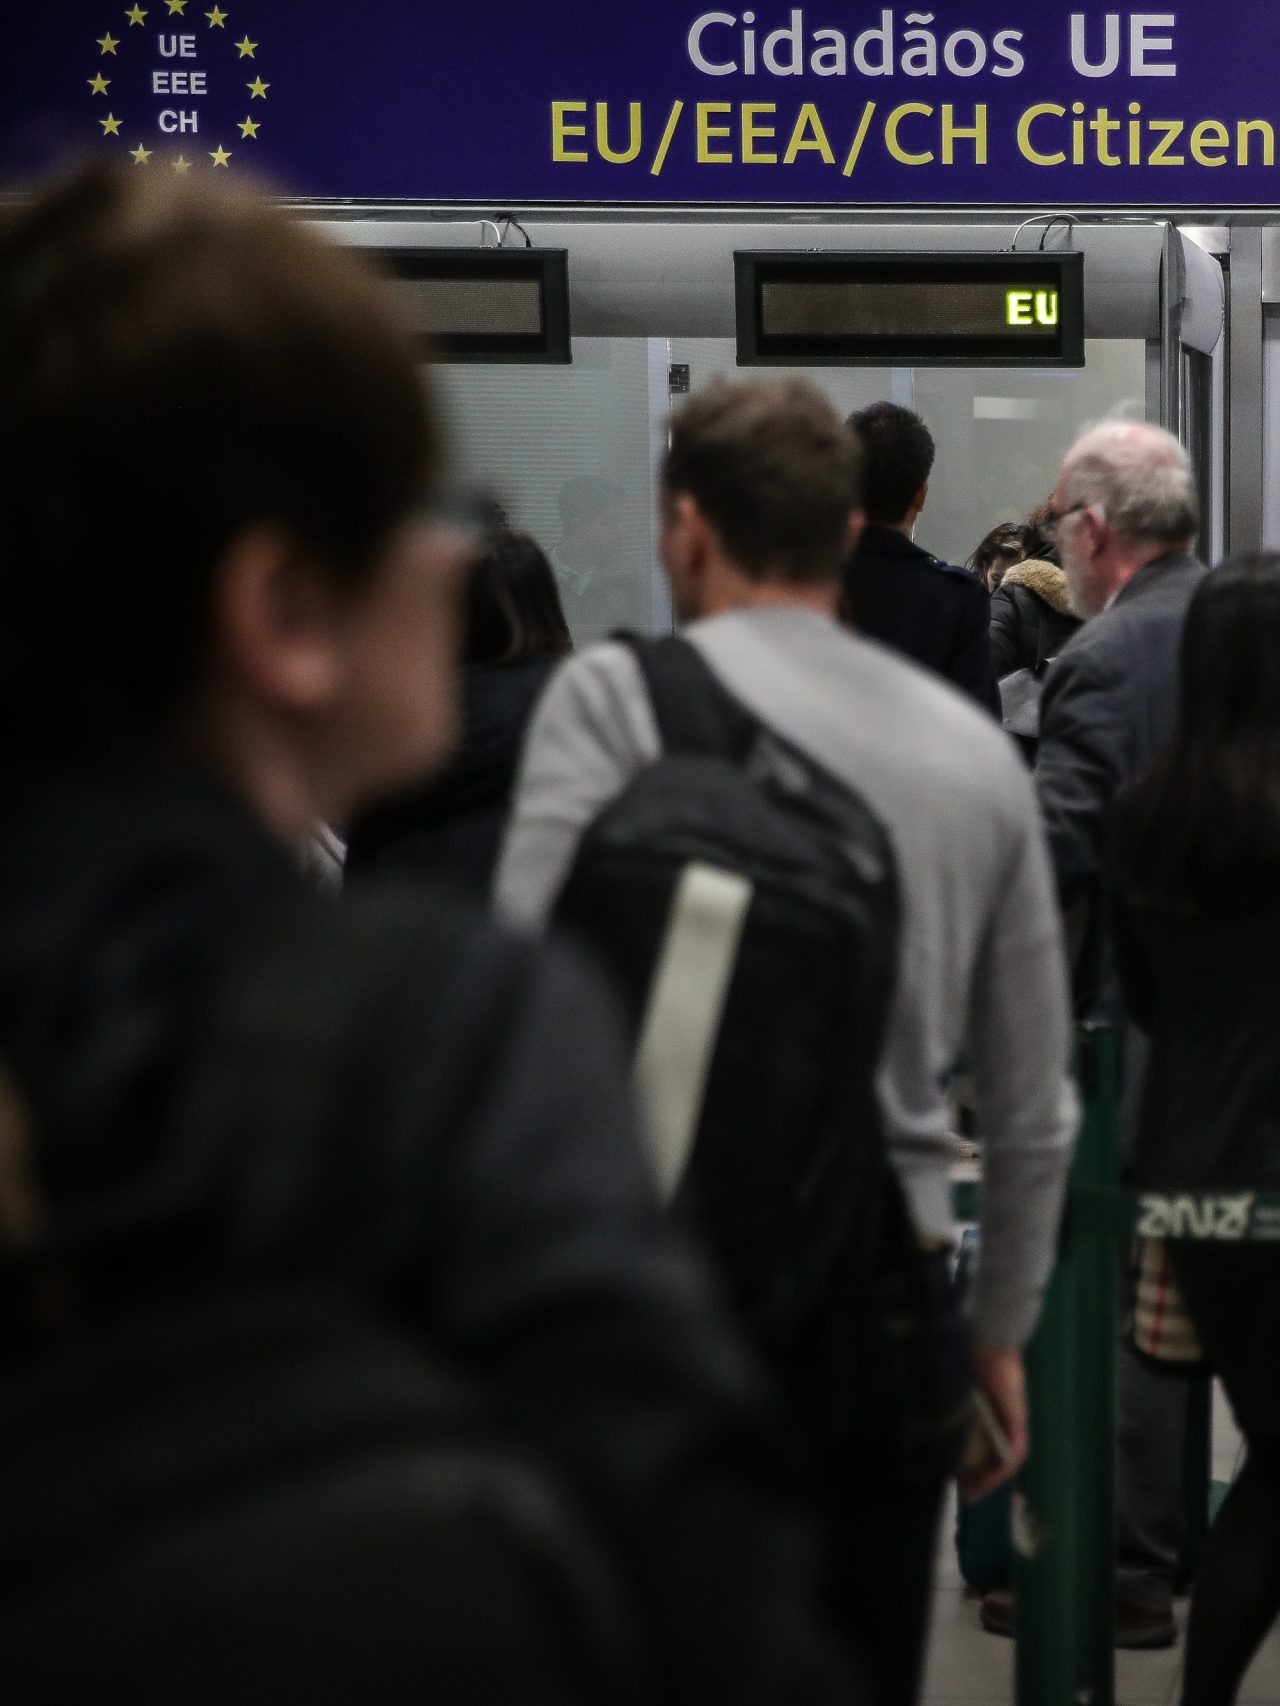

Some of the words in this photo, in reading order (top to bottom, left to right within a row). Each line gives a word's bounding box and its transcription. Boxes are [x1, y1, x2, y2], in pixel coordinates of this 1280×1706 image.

[159, 34, 197, 58] UE
[687, 9, 1026, 78] Cidadãos
[1070, 13, 1178, 79] UE
[152, 71, 208, 95] EEE
[158, 109, 198, 133] CH
[551, 101, 989, 177] EU/EEA/CH
[1007, 290, 1059, 325] EU
